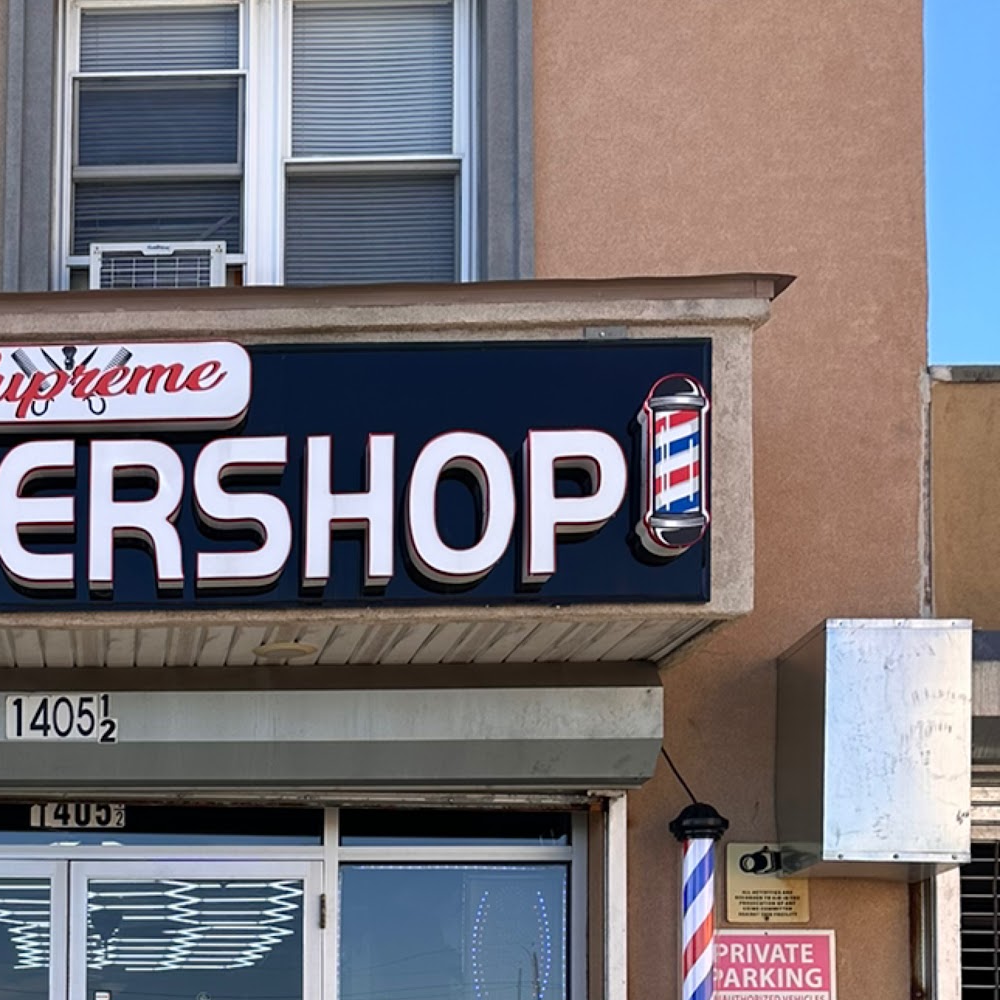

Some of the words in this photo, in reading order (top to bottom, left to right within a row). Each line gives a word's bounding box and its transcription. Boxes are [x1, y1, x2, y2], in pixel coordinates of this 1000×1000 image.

[12, 697, 95, 737] 1405
[716, 943, 814, 963] PRIVATE
[713, 967, 823, 988] PARKING
